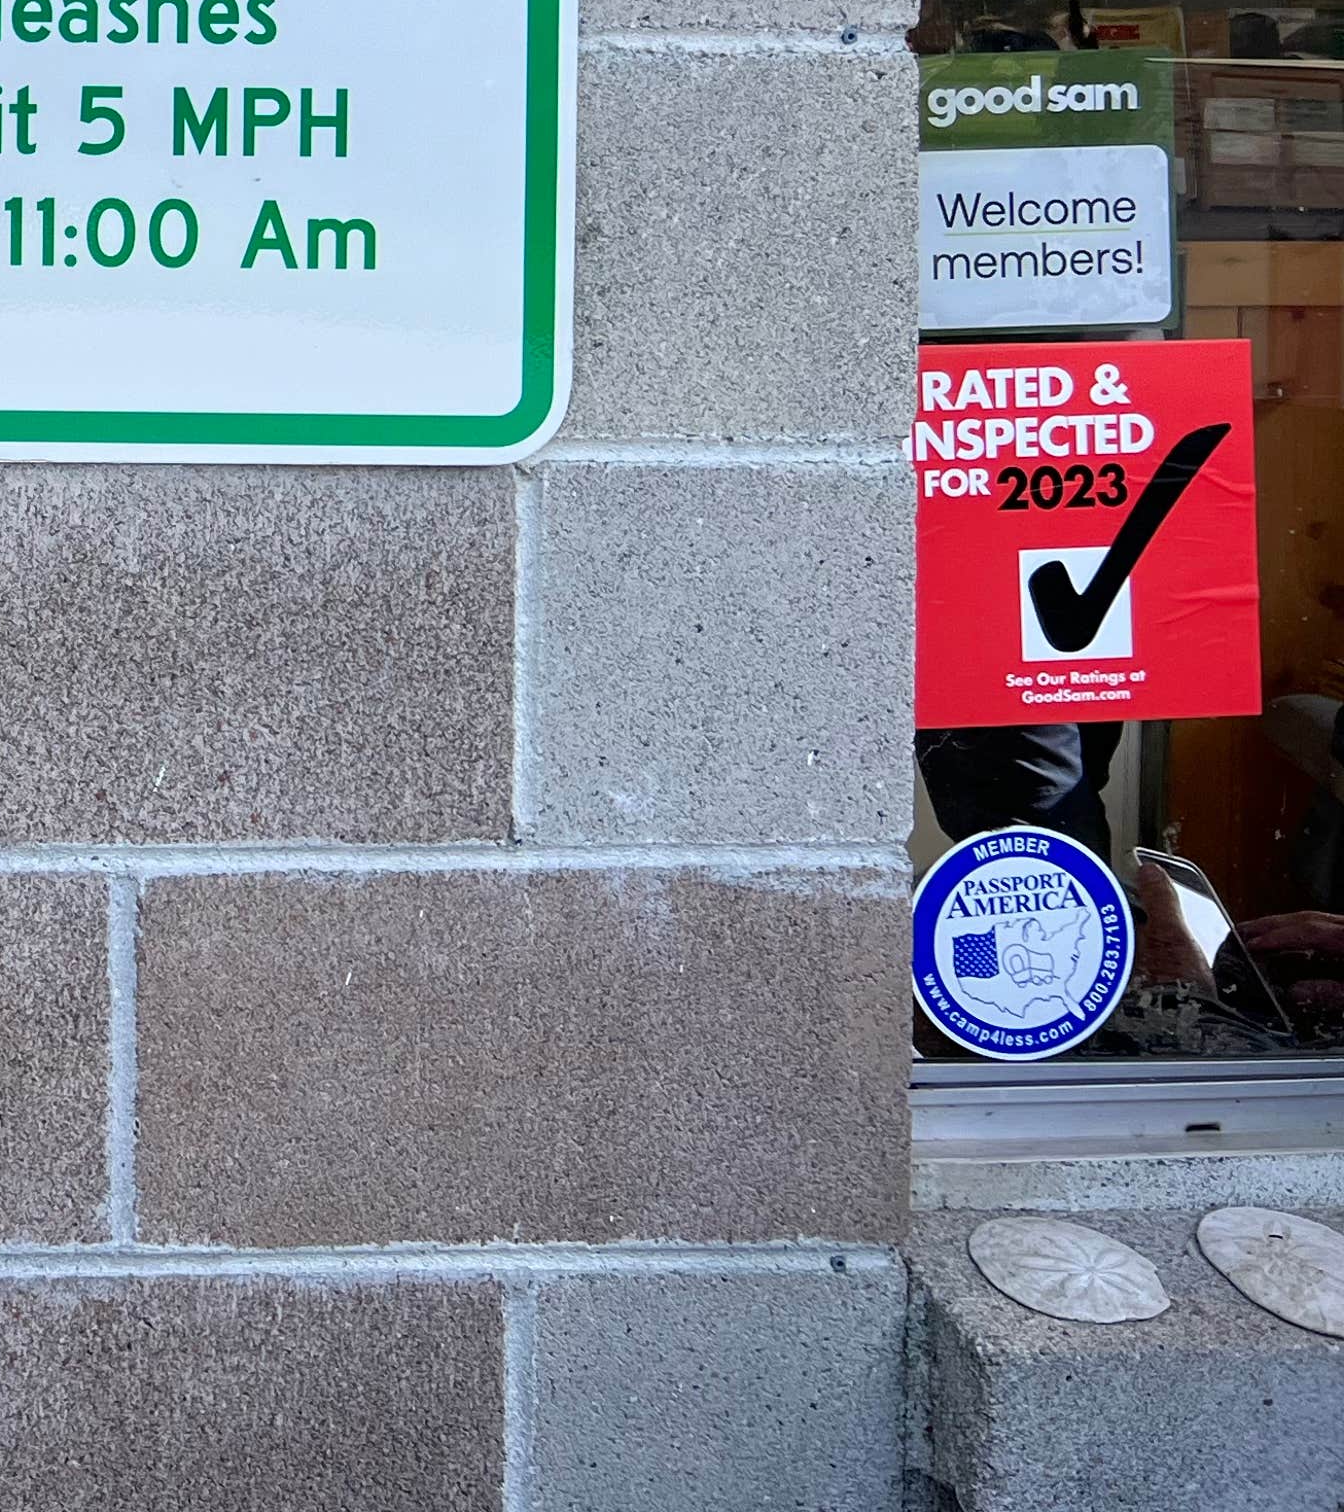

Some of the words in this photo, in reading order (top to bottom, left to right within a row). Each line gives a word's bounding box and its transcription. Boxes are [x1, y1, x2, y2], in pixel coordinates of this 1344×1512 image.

[78, 83, 127, 157] 5
[172, 85, 350, 160] MPH
[937, 192, 1136, 228] Welcome
[3, 194, 201, 270] 11:00
[240, 199, 378, 272] Am
[932, 240, 1143, 279] members!
[921, 365, 1074, 411] RATED
[1089, 363, 1131, 406] &
[923, 468, 991, 498] FOR
[996, 463, 1128, 511] 2023
[1005, 672, 1033, 688] See
[1037, 671, 1067, 687] Our
[1070, 669, 1126, 688] Ratings
[1128, 669, 1146, 683] at
[1021, 687, 1131, 705] GoodSam.com
[972, 837, 1051, 862] MEMBER
[946, 879, 1087, 919] AMERICA
[963, 872, 1067, 896] PASSPORT
[1083, 904, 1121, 1012] 800.283.7183
[923, 973, 1074, 1047] www.camp4less.com
